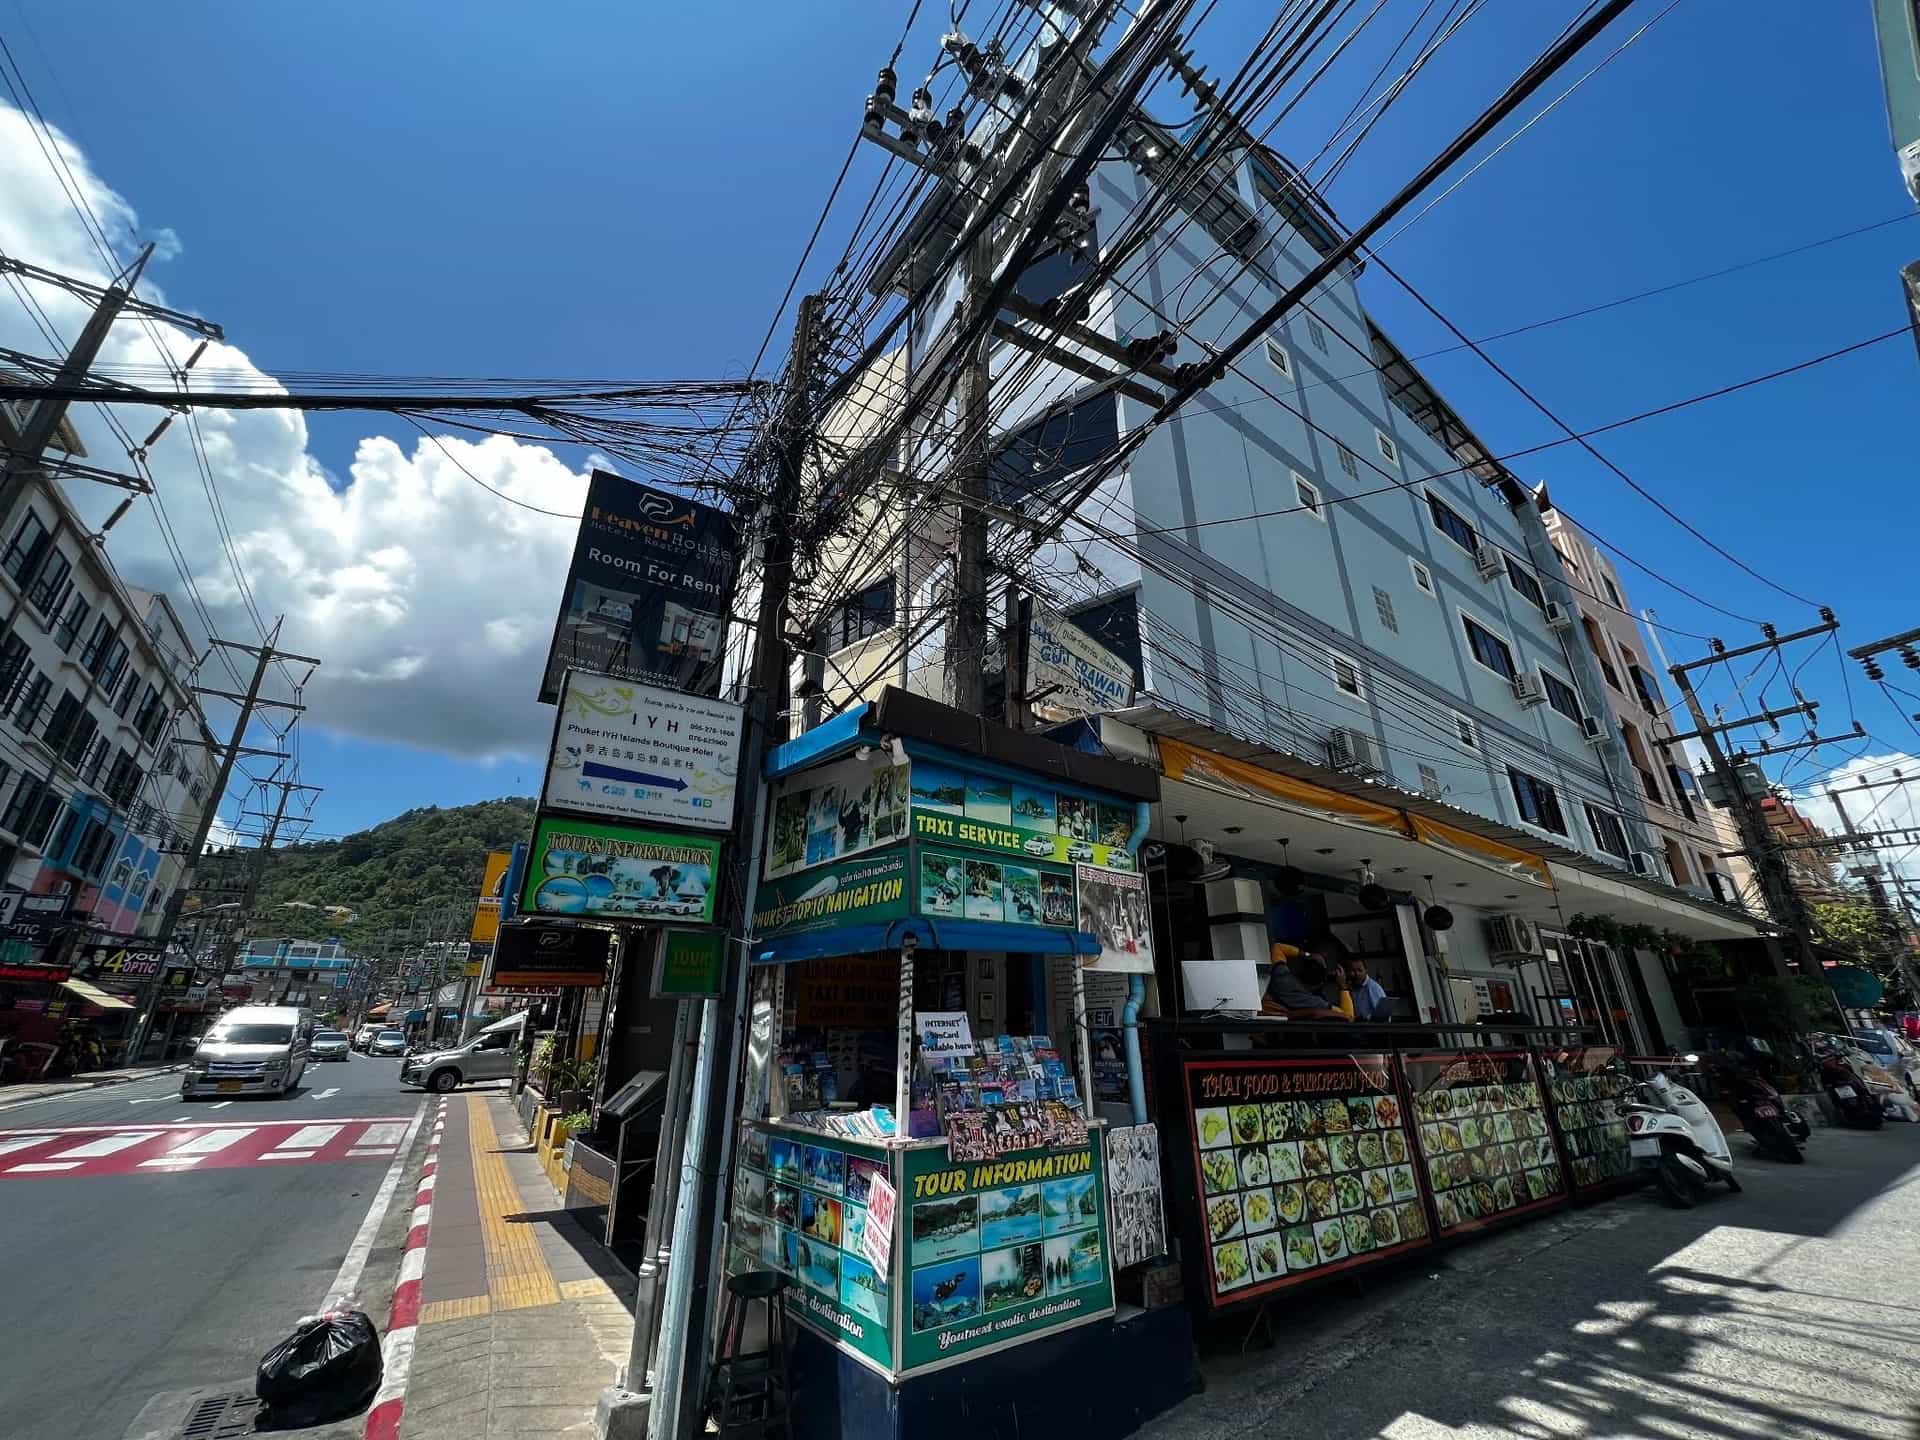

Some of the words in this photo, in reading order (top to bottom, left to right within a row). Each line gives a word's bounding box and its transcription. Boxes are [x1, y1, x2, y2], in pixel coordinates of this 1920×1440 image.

[587, 546, 641, 574] Room
[647, 566, 677, 583] For
[682, 574, 721, 596] Rent
[567, 722, 601, 738] Phuket
[619, 733, 652, 747] Islands
[652, 739, 692, 754] Boutique
[692, 745, 714, 758] Hotel
[548, 832, 604, 852] TOURS
[607, 837, 713, 865] INFORMATION
[916, 814, 954, 838] TAXI
[959, 822, 1021, 849] SERVICE
[826, 876, 904, 915] NAVIGATION
[122, 960, 159, 975] OPTIC
[924, 1019, 961, 1028] INTERNET
[1242, 1072, 1280, 1101] FOOD
[914, 1169, 967, 1199] TOUR
[970, 1150, 1092, 1190] INFORMATION
[808, 1295, 866, 1341] destination
[993, 1311, 1026, 1332] exotic
[1028, 1297, 1083, 1320] destination
